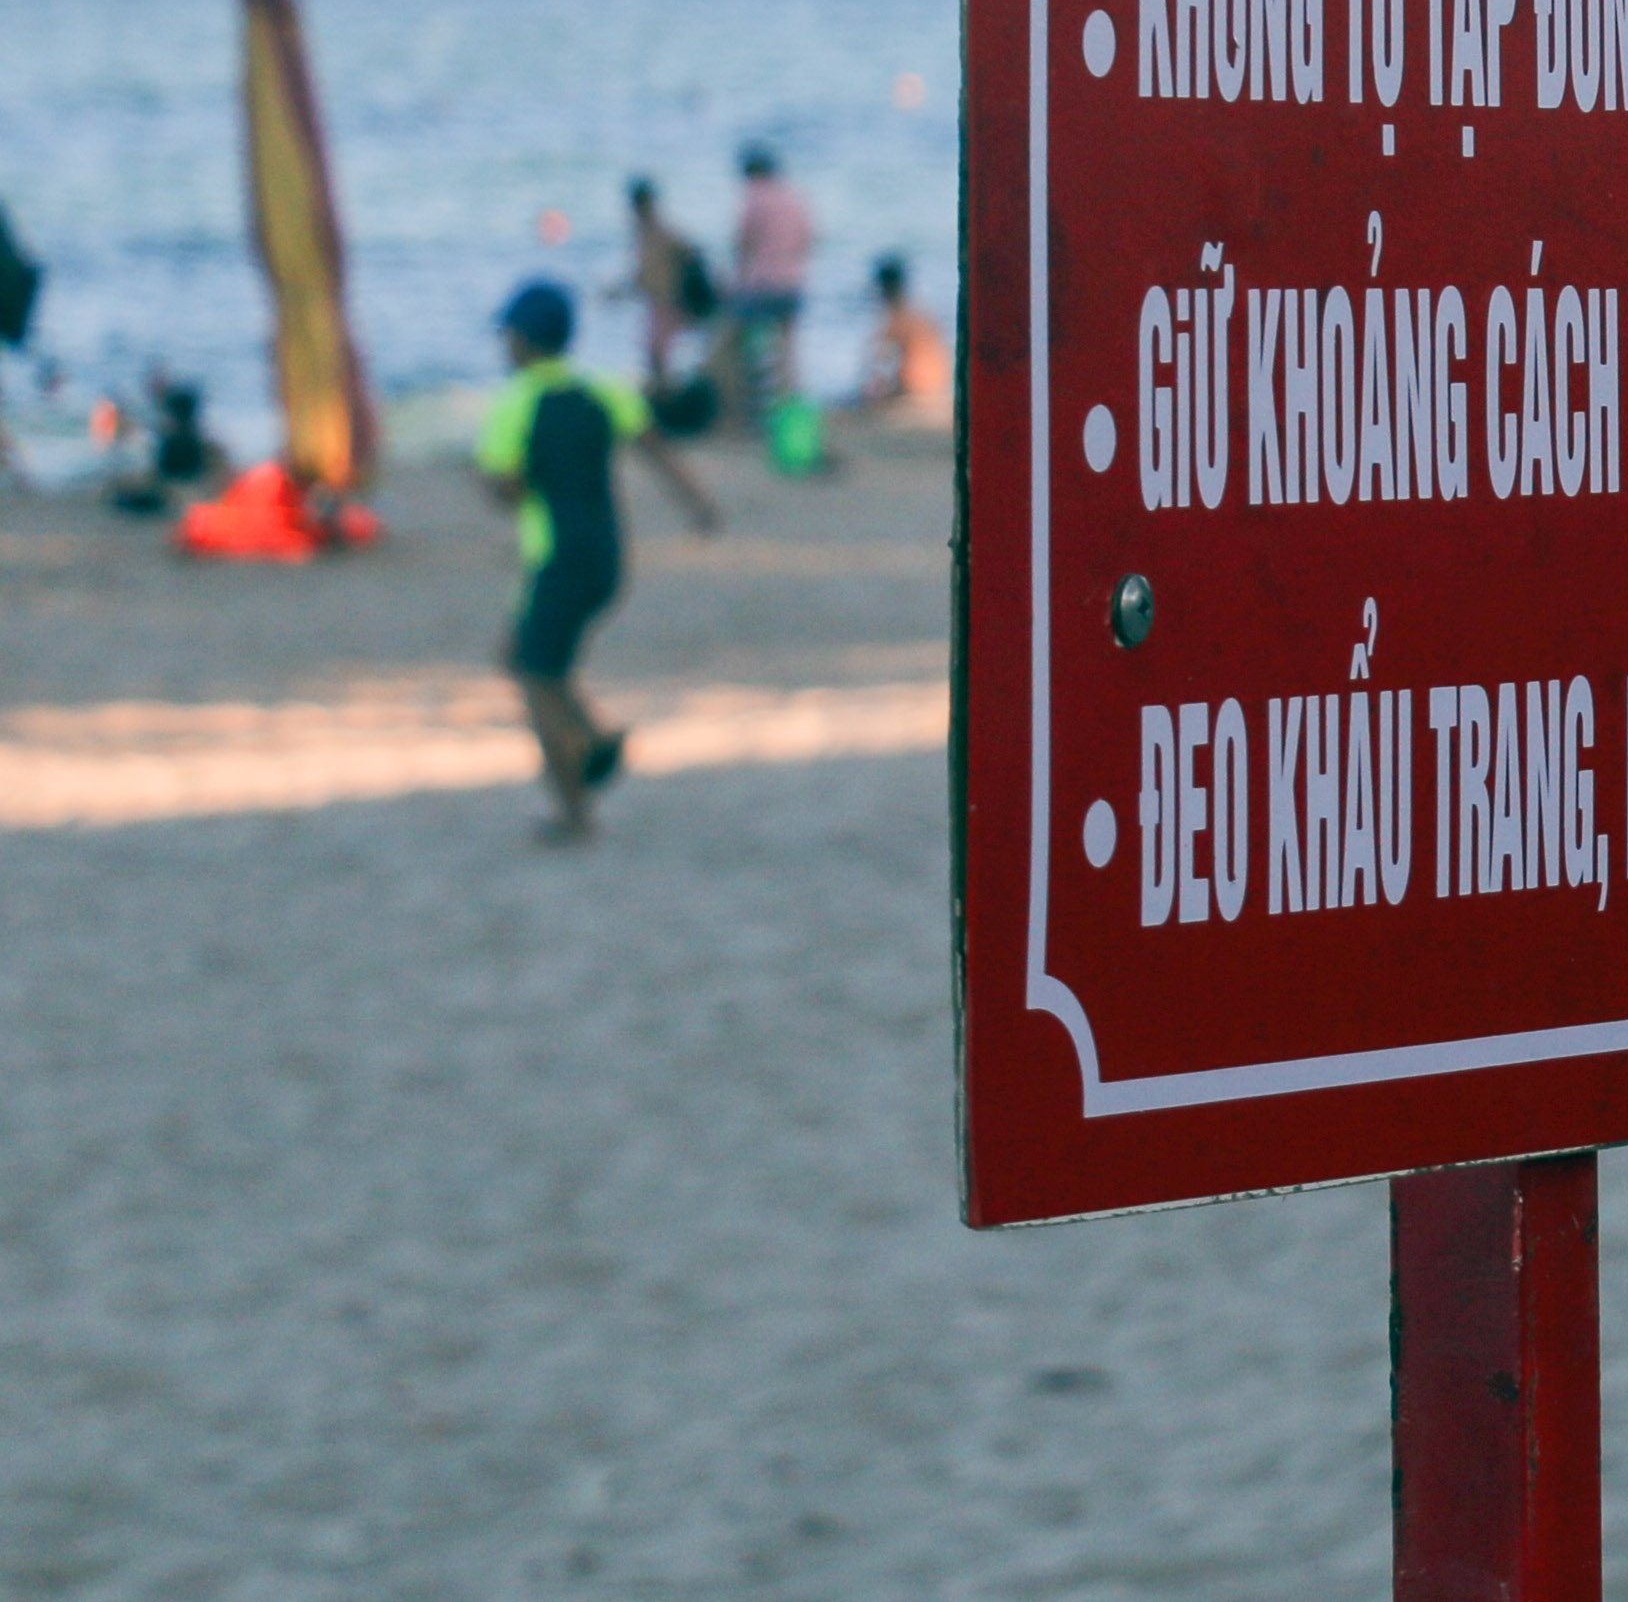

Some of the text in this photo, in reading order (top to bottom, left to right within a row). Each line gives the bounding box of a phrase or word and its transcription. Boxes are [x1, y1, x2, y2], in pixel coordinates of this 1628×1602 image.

[1248, 210, 1468, 505] KHOẢNG
[1486, 240, 1620, 500] CÁCH
[1139, 697, 1248, 927] ĐEO
[1268, 597, 1412, 915] KHẨU
[1429, 673, 1608, 911] TRANG,
